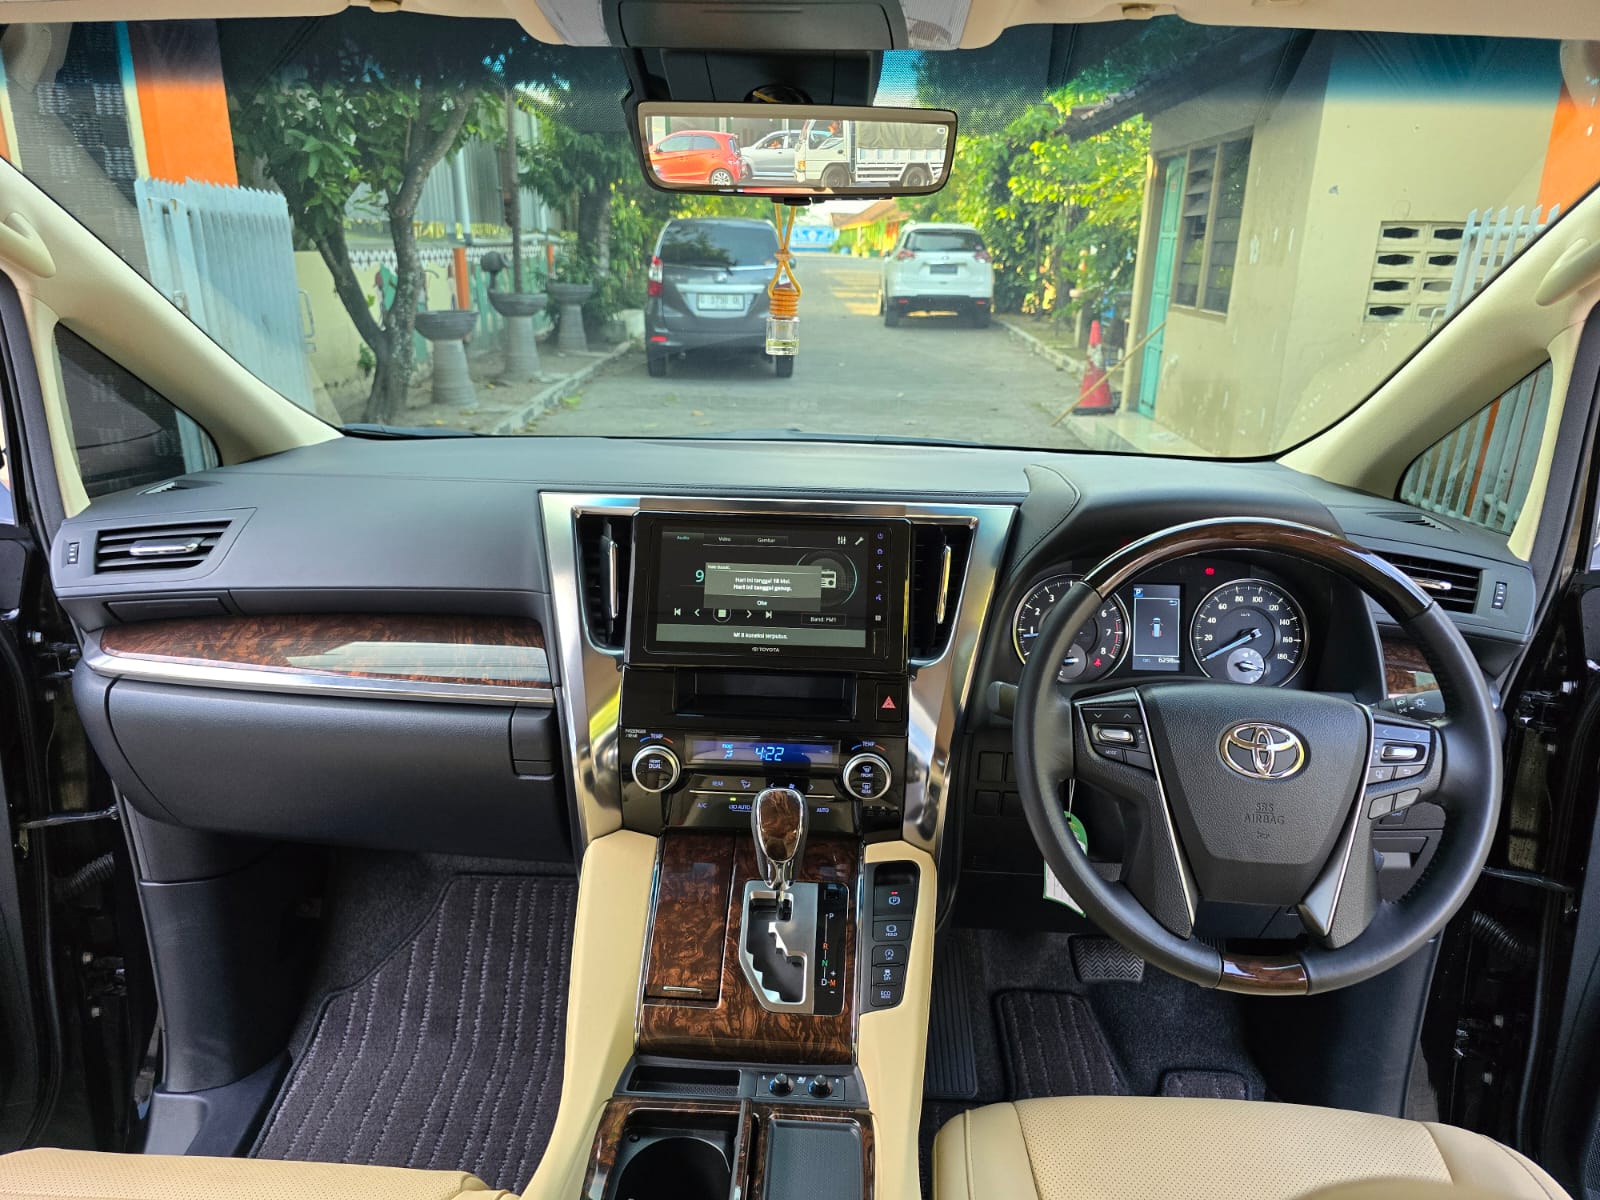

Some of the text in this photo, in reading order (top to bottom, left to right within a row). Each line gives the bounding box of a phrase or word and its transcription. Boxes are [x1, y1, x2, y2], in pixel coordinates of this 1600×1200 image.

[695, 569, 705, 583] 9
[755, 746, 785, 761] 4:22
[1255, 803, 1274, 812] SRS
[1244, 813, 1285, 825] AIRBAG
[821, 959, 828, 967] N
[821, 978, 828, 986] D
